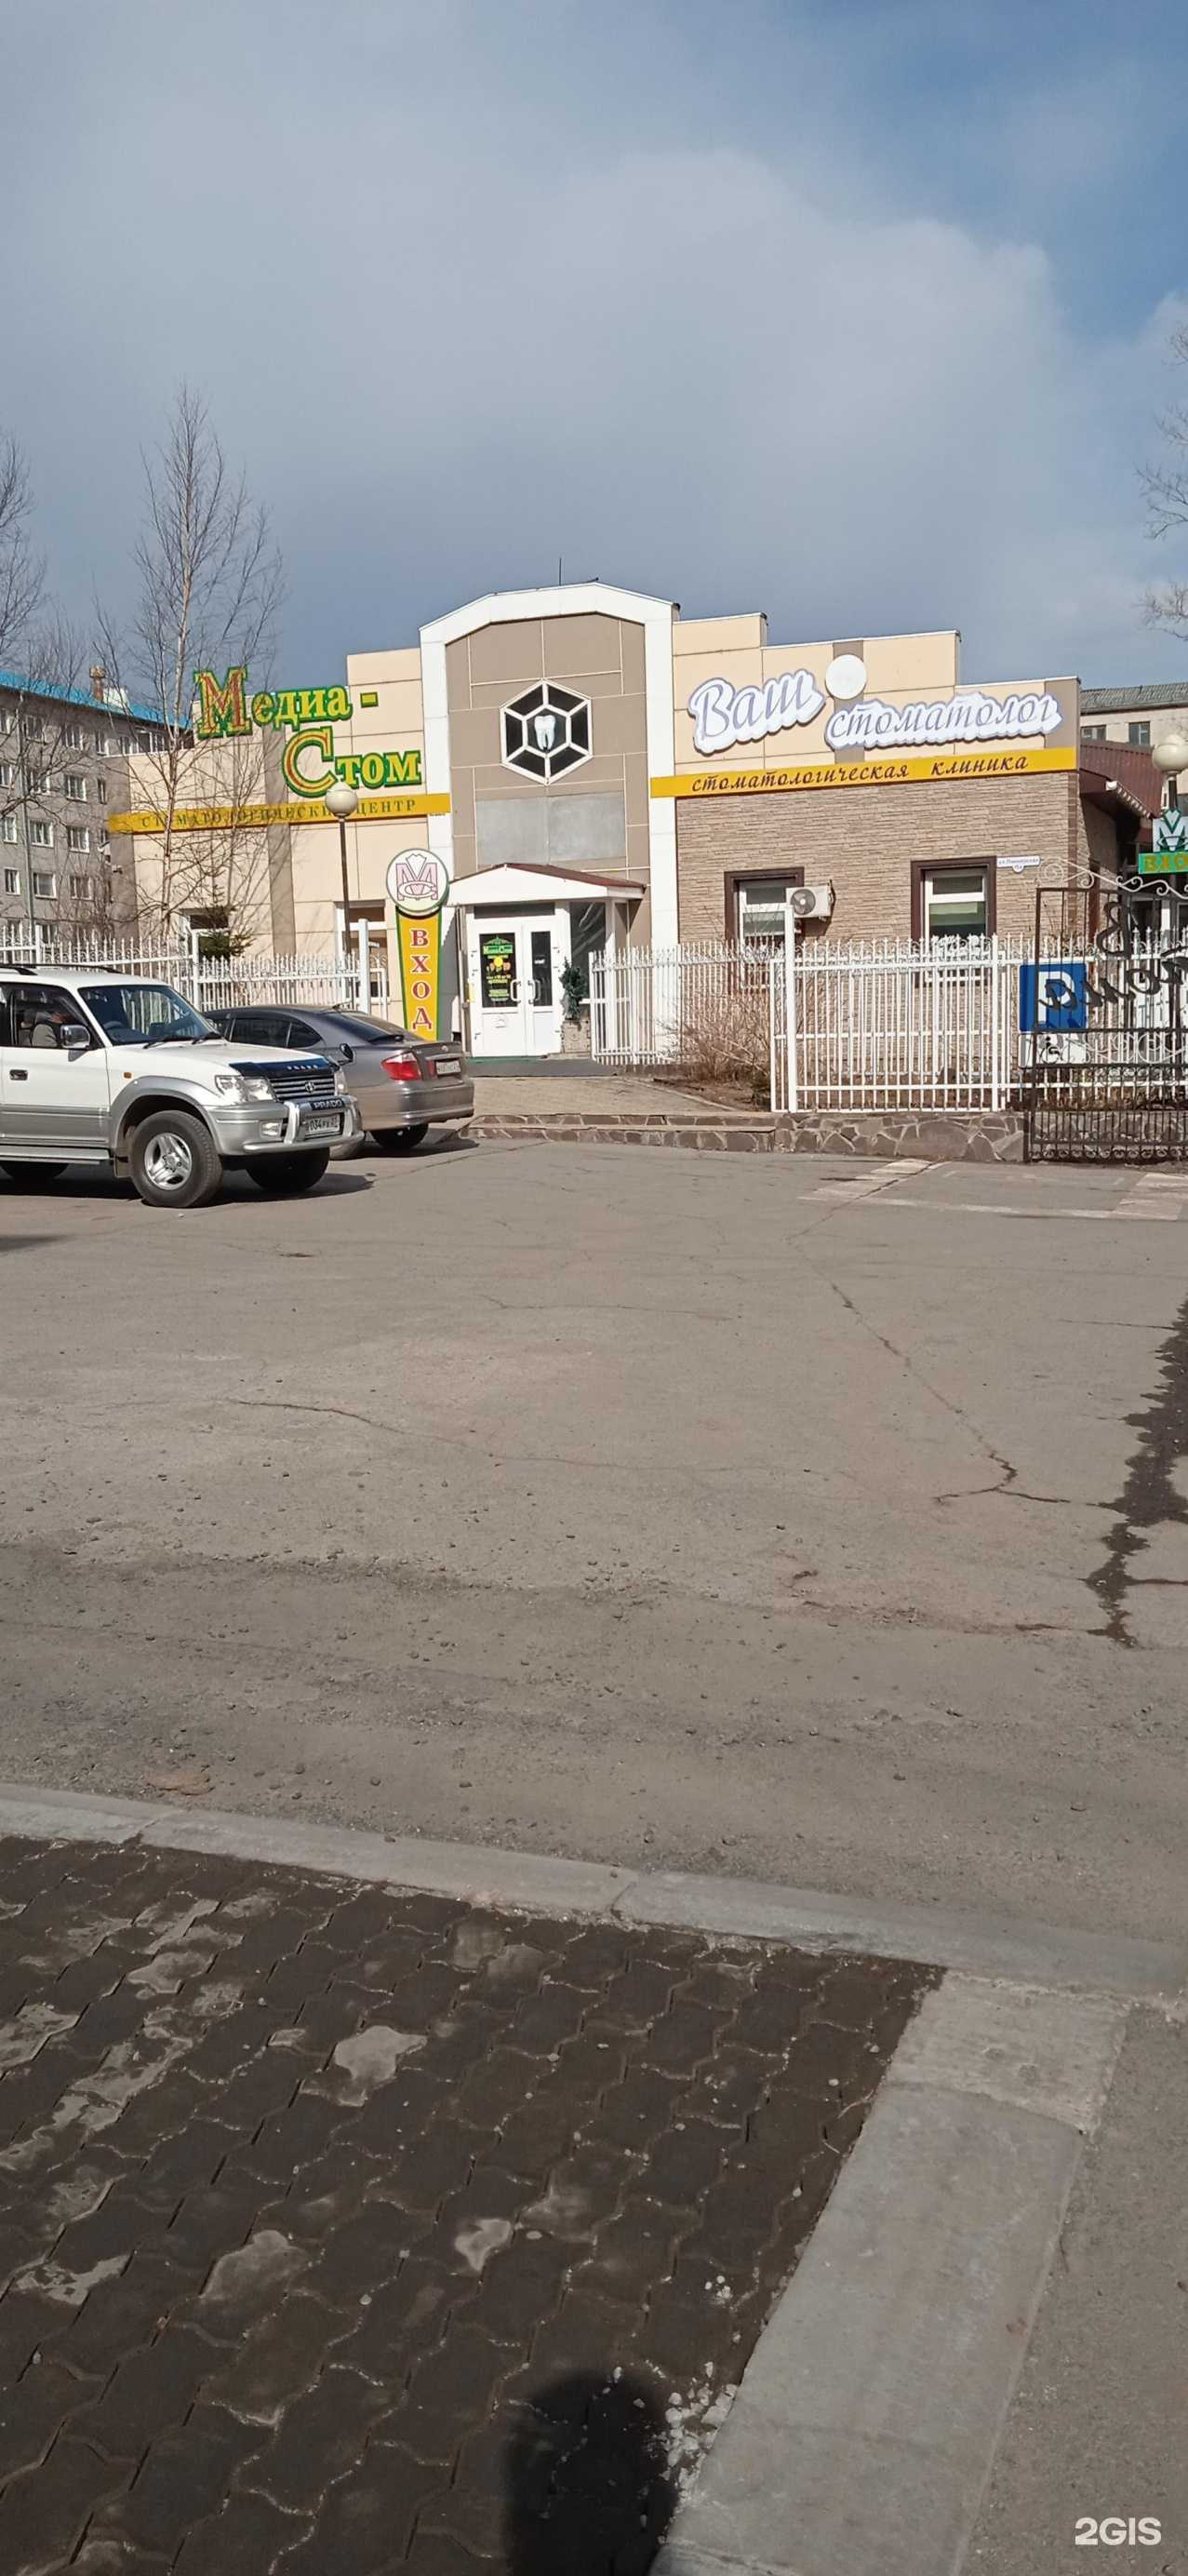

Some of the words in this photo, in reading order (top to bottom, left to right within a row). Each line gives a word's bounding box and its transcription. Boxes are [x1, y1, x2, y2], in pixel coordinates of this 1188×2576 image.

[691, 671, 819, 749] Ваш
[828, 696, 1055, 745] стоматолог
[691, 763, 909, 792] стоматологическая
[930, 755, 1028, 776] клиника
[357, 799, 417, 818] ЦЕНТР
[410, 929, 433, 1030] ВХОД
[314, 1099, 342, 1109] PRADO
